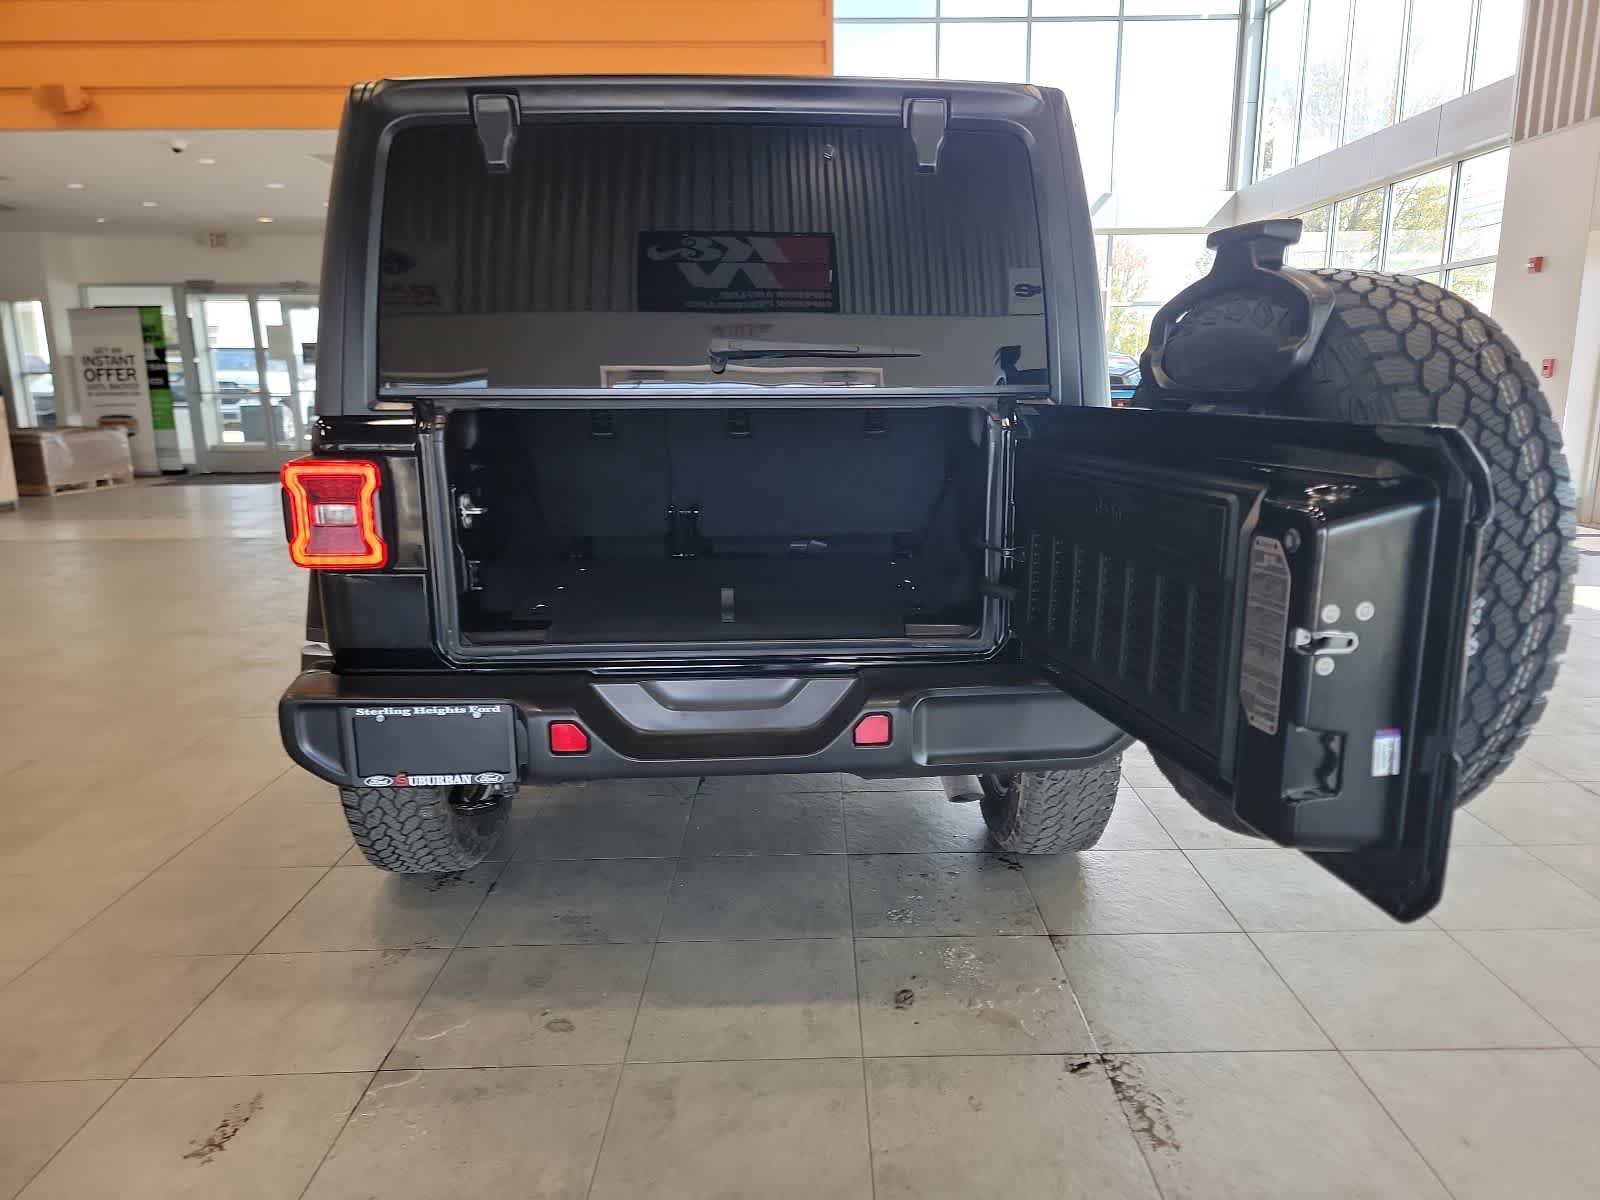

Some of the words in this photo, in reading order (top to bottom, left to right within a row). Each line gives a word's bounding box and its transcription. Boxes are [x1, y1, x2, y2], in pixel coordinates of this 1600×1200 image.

[81, 354, 135, 367] INSTANT
[83, 367, 137, 382] OFFER
[355, 707, 411, 717] Sterling
[413, 706, 467, 716] Heights
[469, 705, 502, 715] Ford
[395, 772, 473, 788] SUBURBAN
